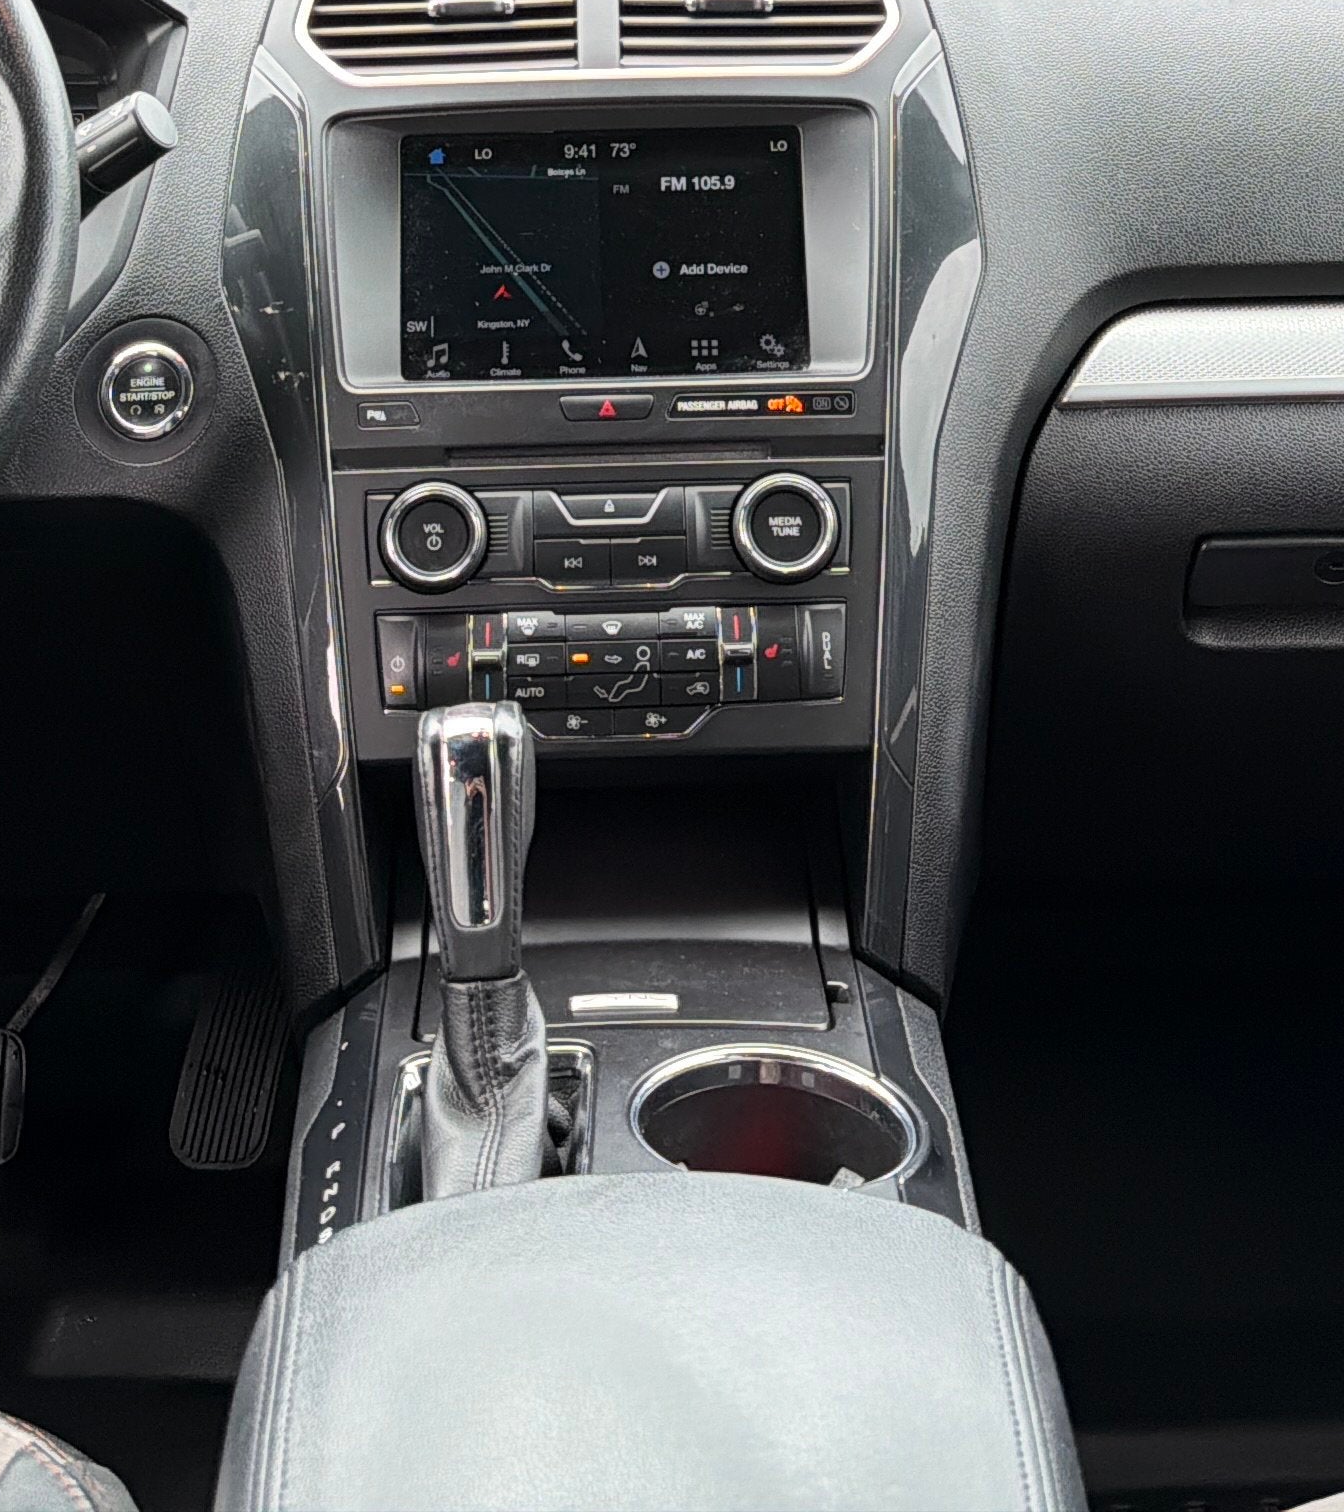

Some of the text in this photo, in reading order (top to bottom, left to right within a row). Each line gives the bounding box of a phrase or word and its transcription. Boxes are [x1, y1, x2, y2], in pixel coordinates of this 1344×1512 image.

[564, 144, 597, 158] 9:41
[770, 140, 788, 152] LO
[474, 148, 492, 160] LO
[660, 175, 735, 192] FM 105.9
[613, 185, 630, 194] FM
[480, 264, 502, 274] John
[515, 264, 539, 273] Clark
[541, 264, 552, 272] Dr
[679, 263, 749, 275] Add Device
[406, 321, 428, 333] SW
[517, 319, 530, 328] NY
[631, 364, 648, 373] Nav
[695, 362, 717, 372] Apps
[756, 360, 790, 370] Settings
[426, 370, 450, 379] Audio
[490, 367, 522, 377] Climate
[559, 366, 586, 375] Phone
[130, 377, 165, 387] ENGINE
[677, 400, 758, 411] PASSENGER AIRBAG
[767, 399, 785, 410] OFF
[815, 399, 829, 408] ON
[768, 516, 802, 526] MEDIA
[423, 523, 444, 534] VOL
[771, 526, 800, 536] TUNE
[516, 617, 539, 626] MAX
[683, 612, 706, 621] MAX
[686, 620, 704, 630] A/C
[686, 649, 706, 659] A/C
[822, 631, 832, 670] DUAL
[515, 687, 545, 697] AUTO
